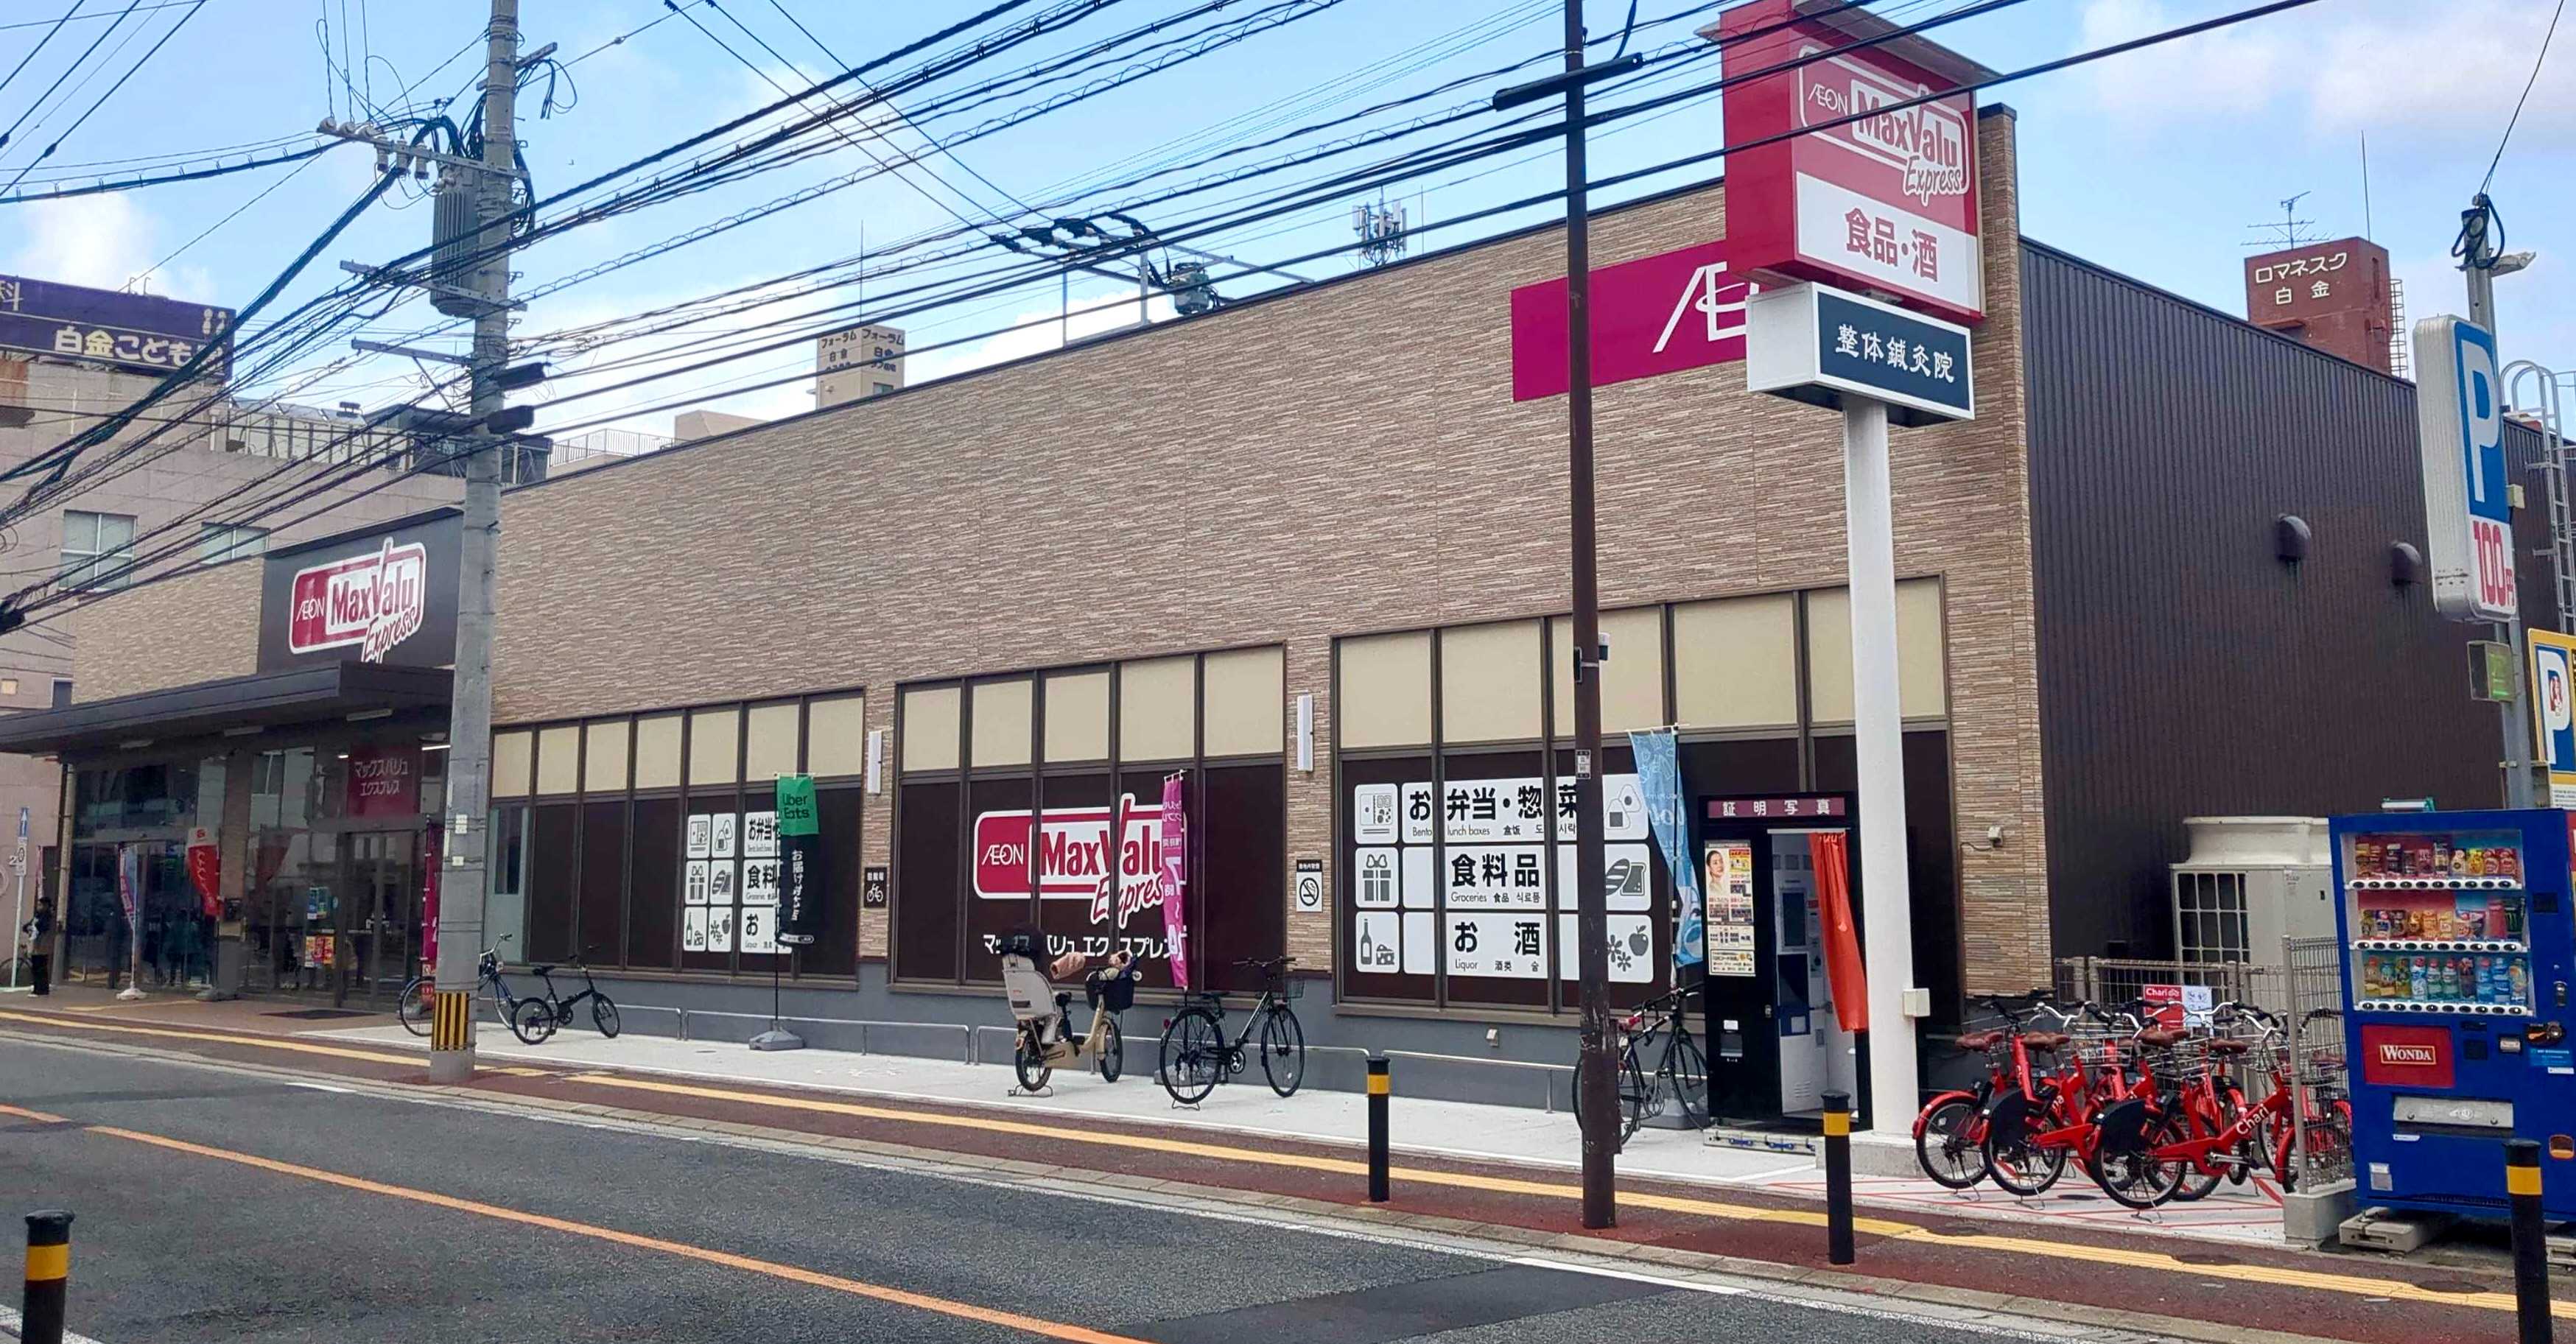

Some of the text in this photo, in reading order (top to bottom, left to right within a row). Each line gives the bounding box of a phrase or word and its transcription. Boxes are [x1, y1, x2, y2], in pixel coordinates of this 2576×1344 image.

[1857, 88, 1958, 167] MaxValu
[1906, 155, 1961, 200] Express
[1845, 207, 1939, 283] 食品・酒
[2255, 252, 2348, 284] ロマネスク
[2275, 280, 2330, 305] 白金
[861, 328, 905, 346] フォーラム
[1835, 323, 1955, 384] 整体鍼灸院
[2460, 339, 2500, 503] P
[331, 542, 415, 627] MaxValu
[365, 606, 416, 659] Express
[782, 792, 808, 806] Uber
[784, 806, 810, 820] Eats
[1722, 798, 1831, 817] 証明写真
[1412, 826, 1433, 837] Bento
[1447, 824, 1466, 837] lunch
[1468, 824, 1491, 836] boxes
[747, 864, 777, 890] 食料
[1450, 853, 1540, 888] 食料品
[1450, 891, 1487, 903] Groceries
[1455, 958, 1478, 972] Liquor
[2382, 1046, 2432, 1063] WONDA
[2236, 1104, 2269, 1135] Chari
